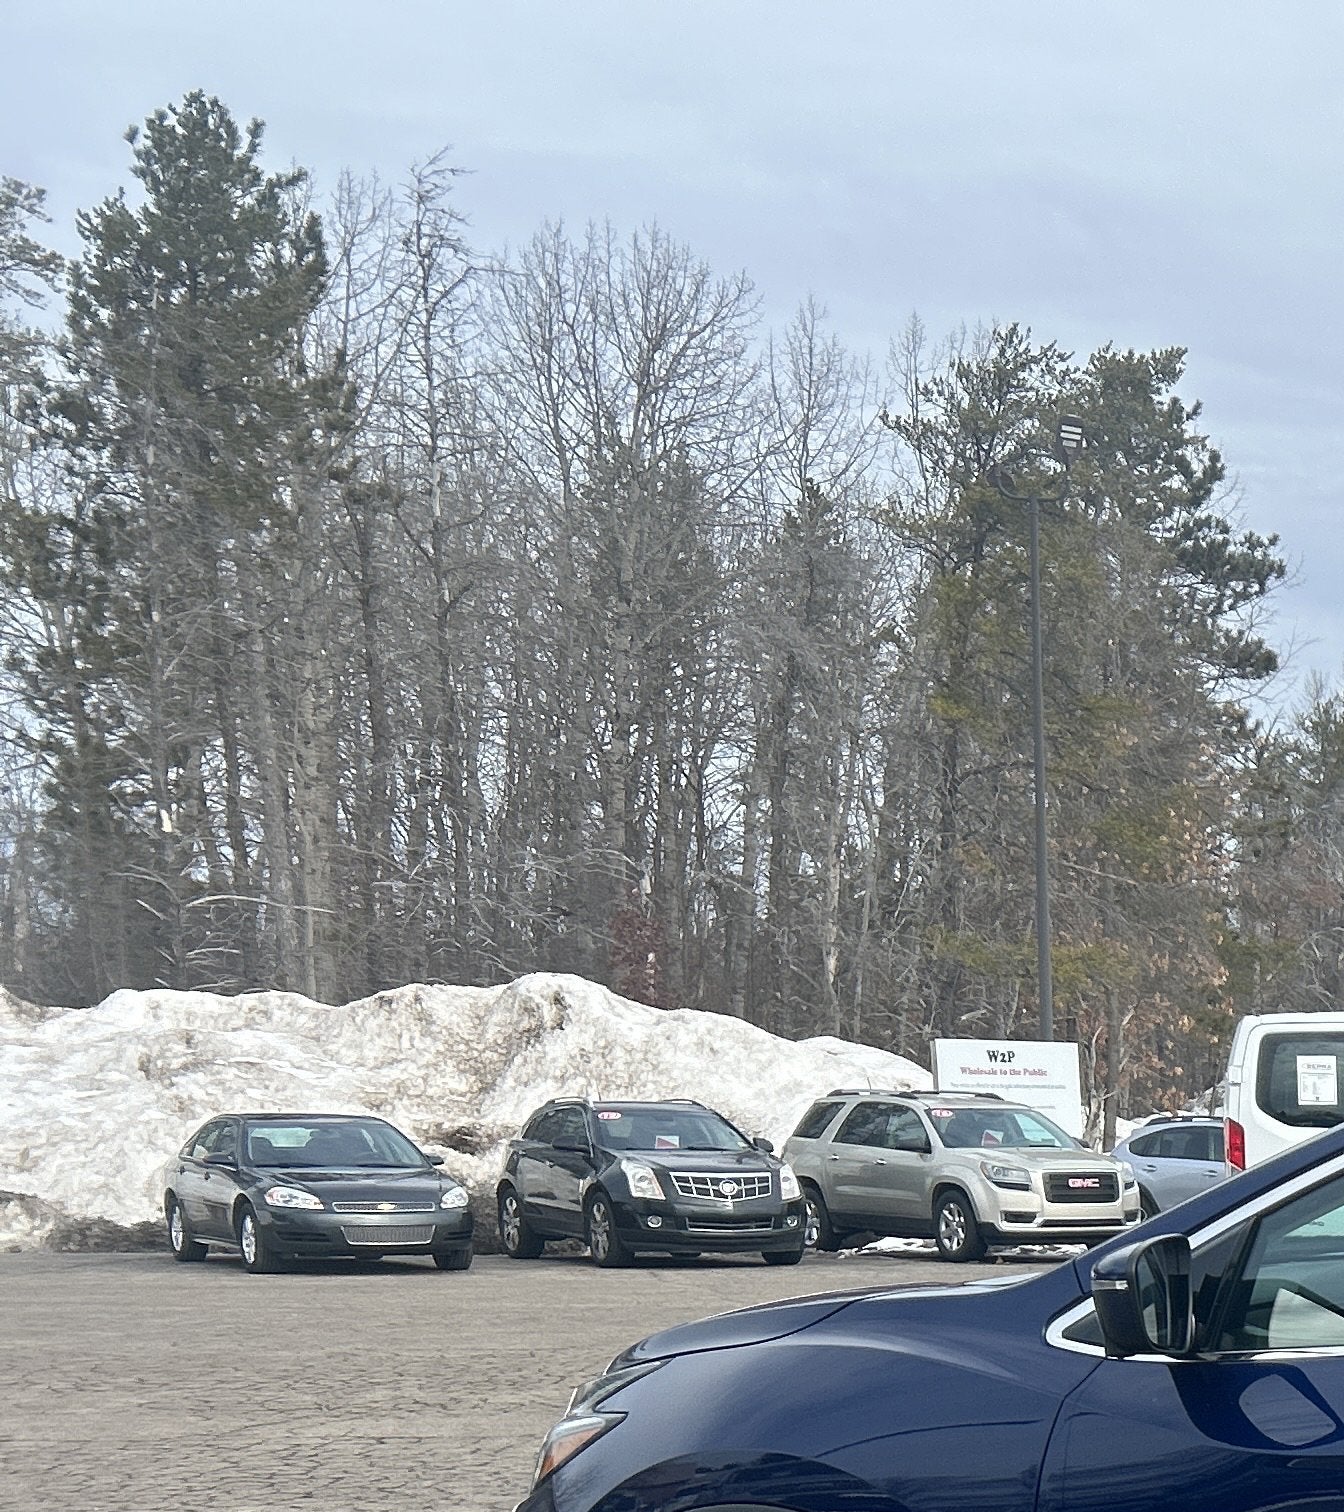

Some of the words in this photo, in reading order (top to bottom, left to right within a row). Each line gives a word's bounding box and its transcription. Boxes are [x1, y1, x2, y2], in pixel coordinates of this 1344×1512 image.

[986, 1050, 1016, 1063] W2P
[1000, 1068, 1008, 1076] to
[1009, 1068, 1022, 1076] the
[1023, 1068, 1048, 1077] Public
[1068, 1178, 1100, 1188] GMC
